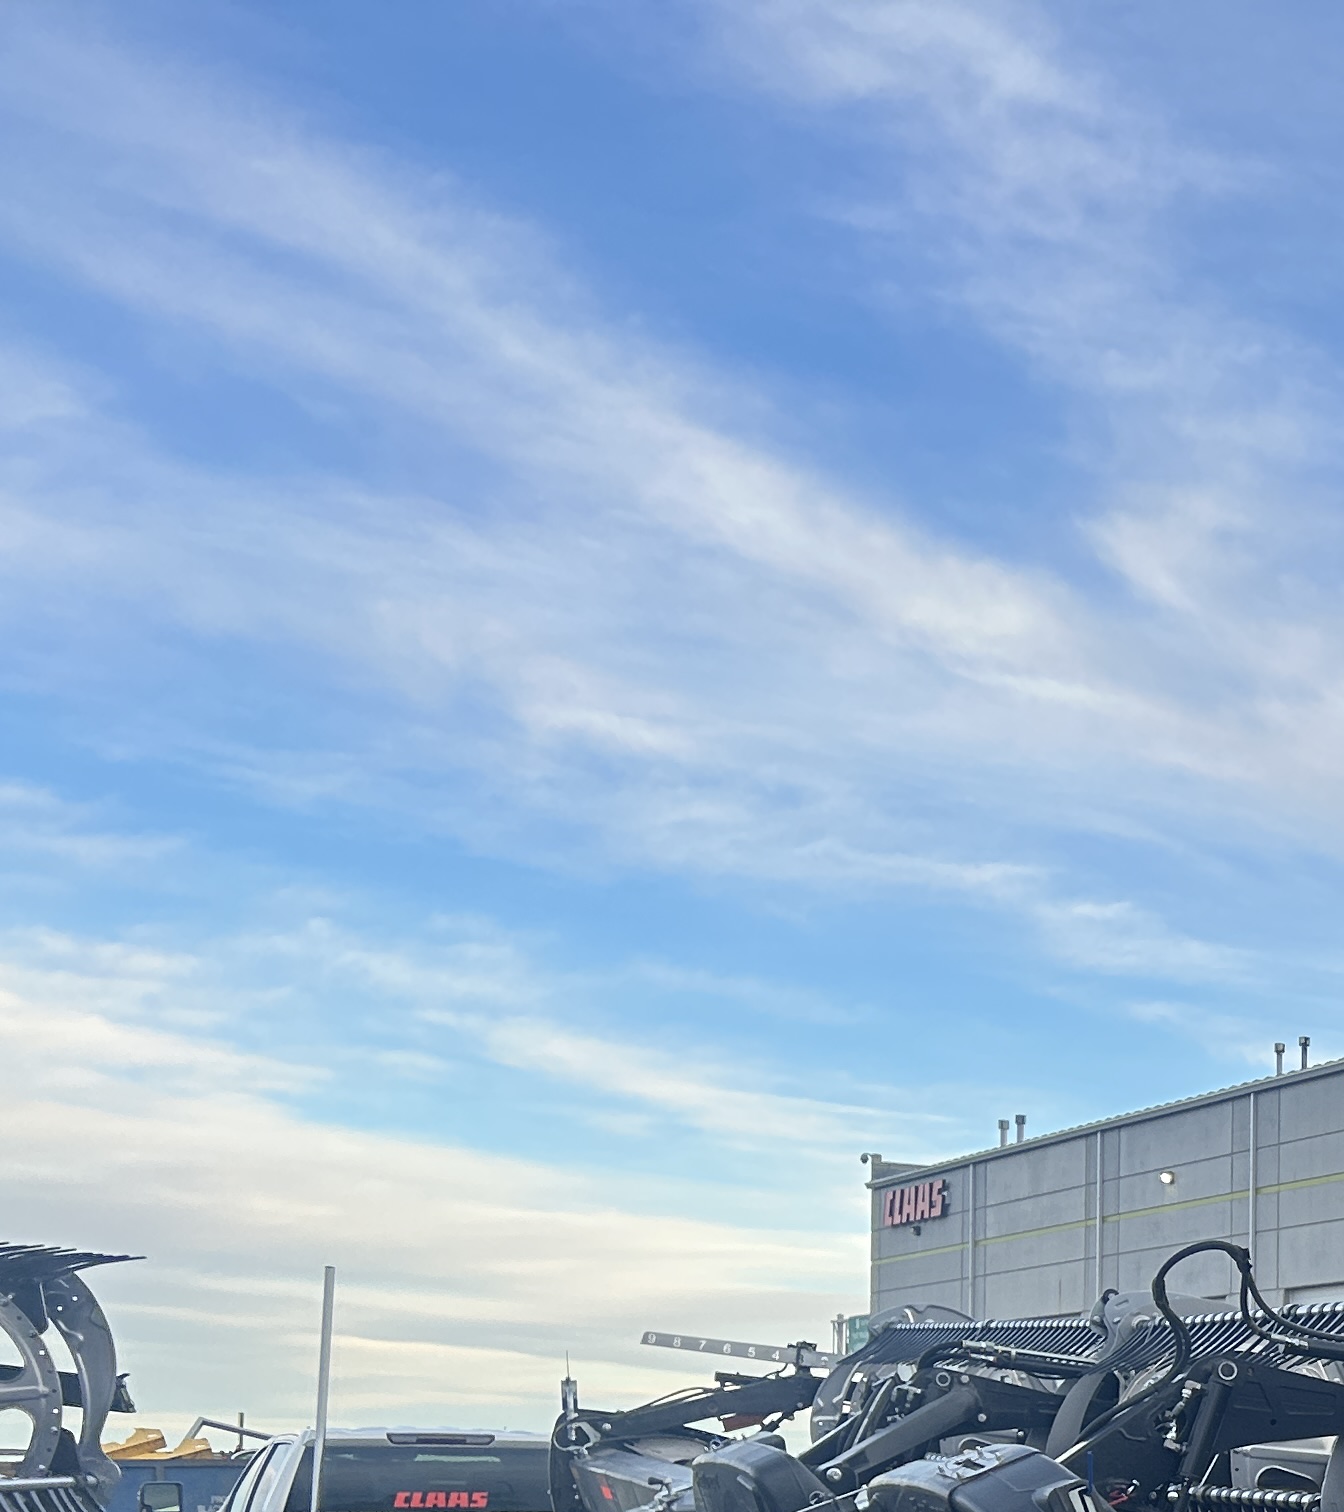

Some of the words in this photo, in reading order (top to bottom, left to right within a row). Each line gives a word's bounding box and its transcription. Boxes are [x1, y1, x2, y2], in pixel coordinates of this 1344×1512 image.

[883, 1178, 943, 1227] CLAAS
[647, 1333, 656, 1344] 9
[673, 1336, 681, 1347] 8
[699, 1340, 707, 1350] 7
[723, 1343, 731, 1354] 6
[747, 1346, 756, 1357] 5
[771, 1350, 780, 1360] 4
[393, 1491, 489, 1508] CLAAS
